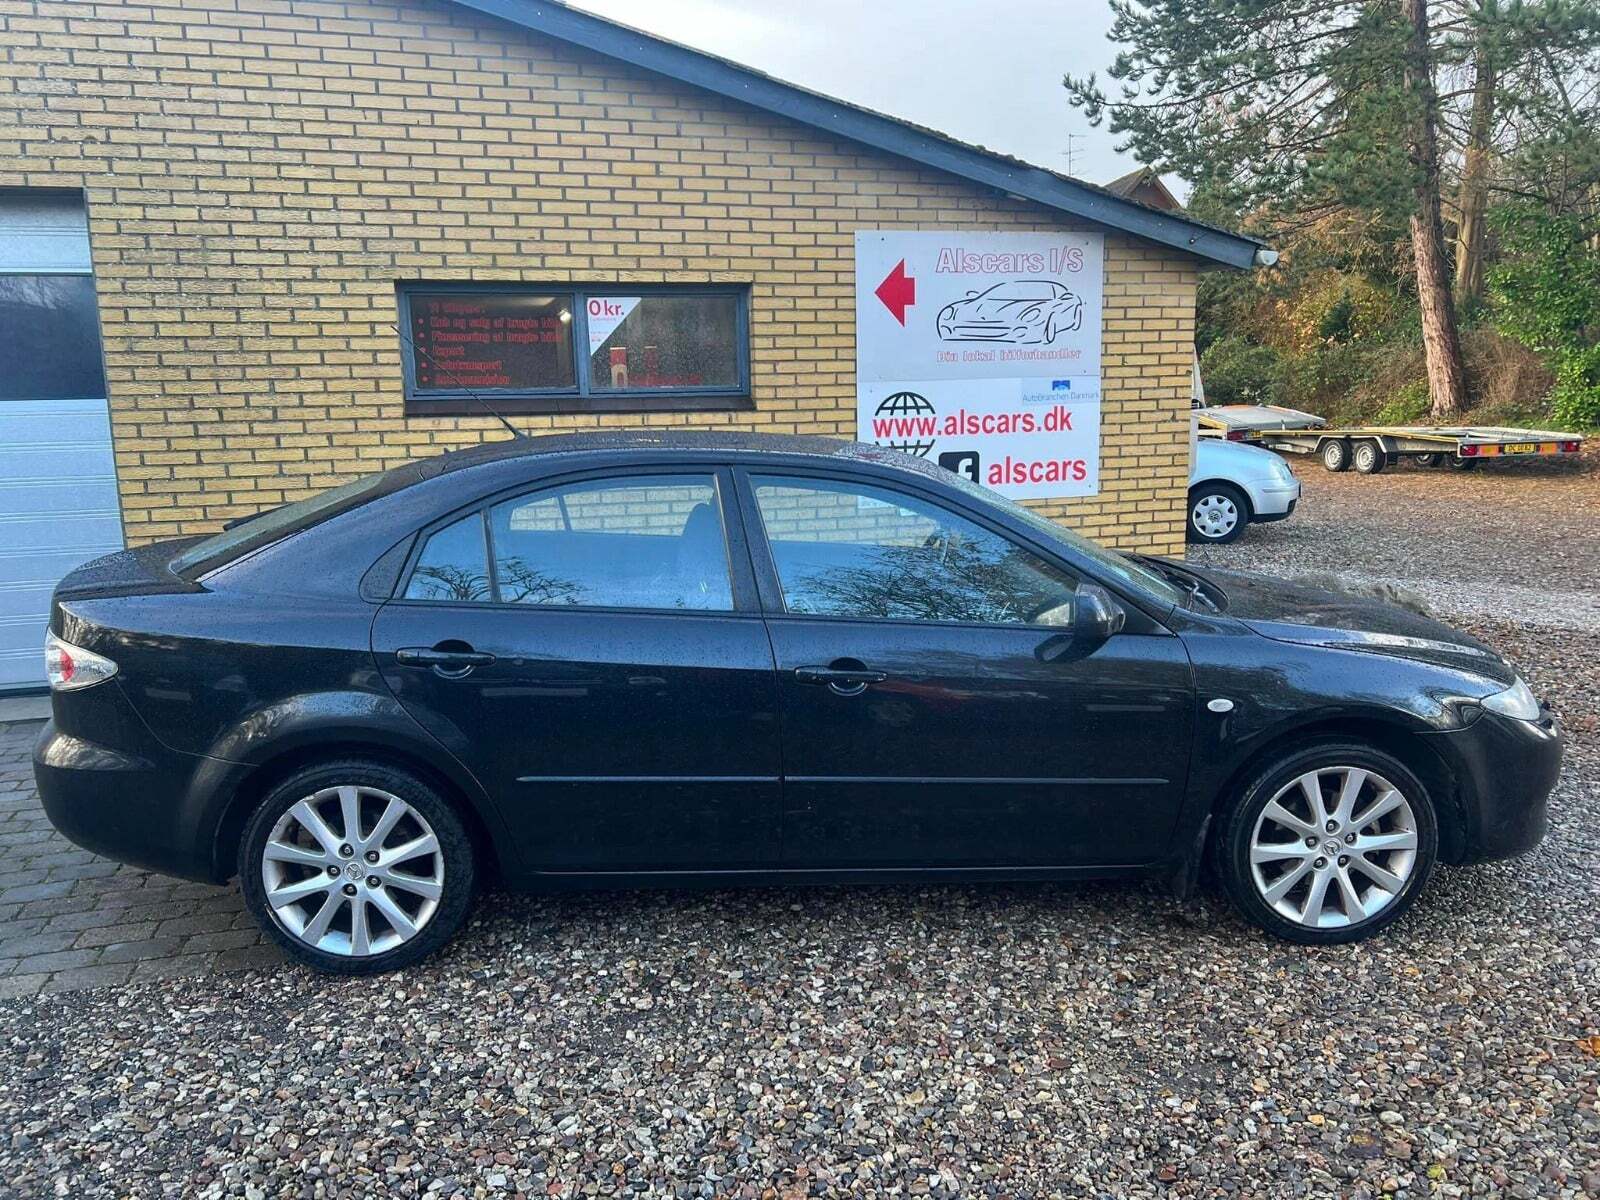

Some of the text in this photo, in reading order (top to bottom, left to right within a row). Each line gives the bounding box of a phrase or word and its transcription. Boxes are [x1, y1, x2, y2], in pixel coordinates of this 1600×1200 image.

[936, 245, 1084, 275] Alscars I/S
[589, 300, 625, 316] 0 kr.
[872, 405, 1073, 438] www.alscars.dk
[988, 456, 1087, 485] alscars
